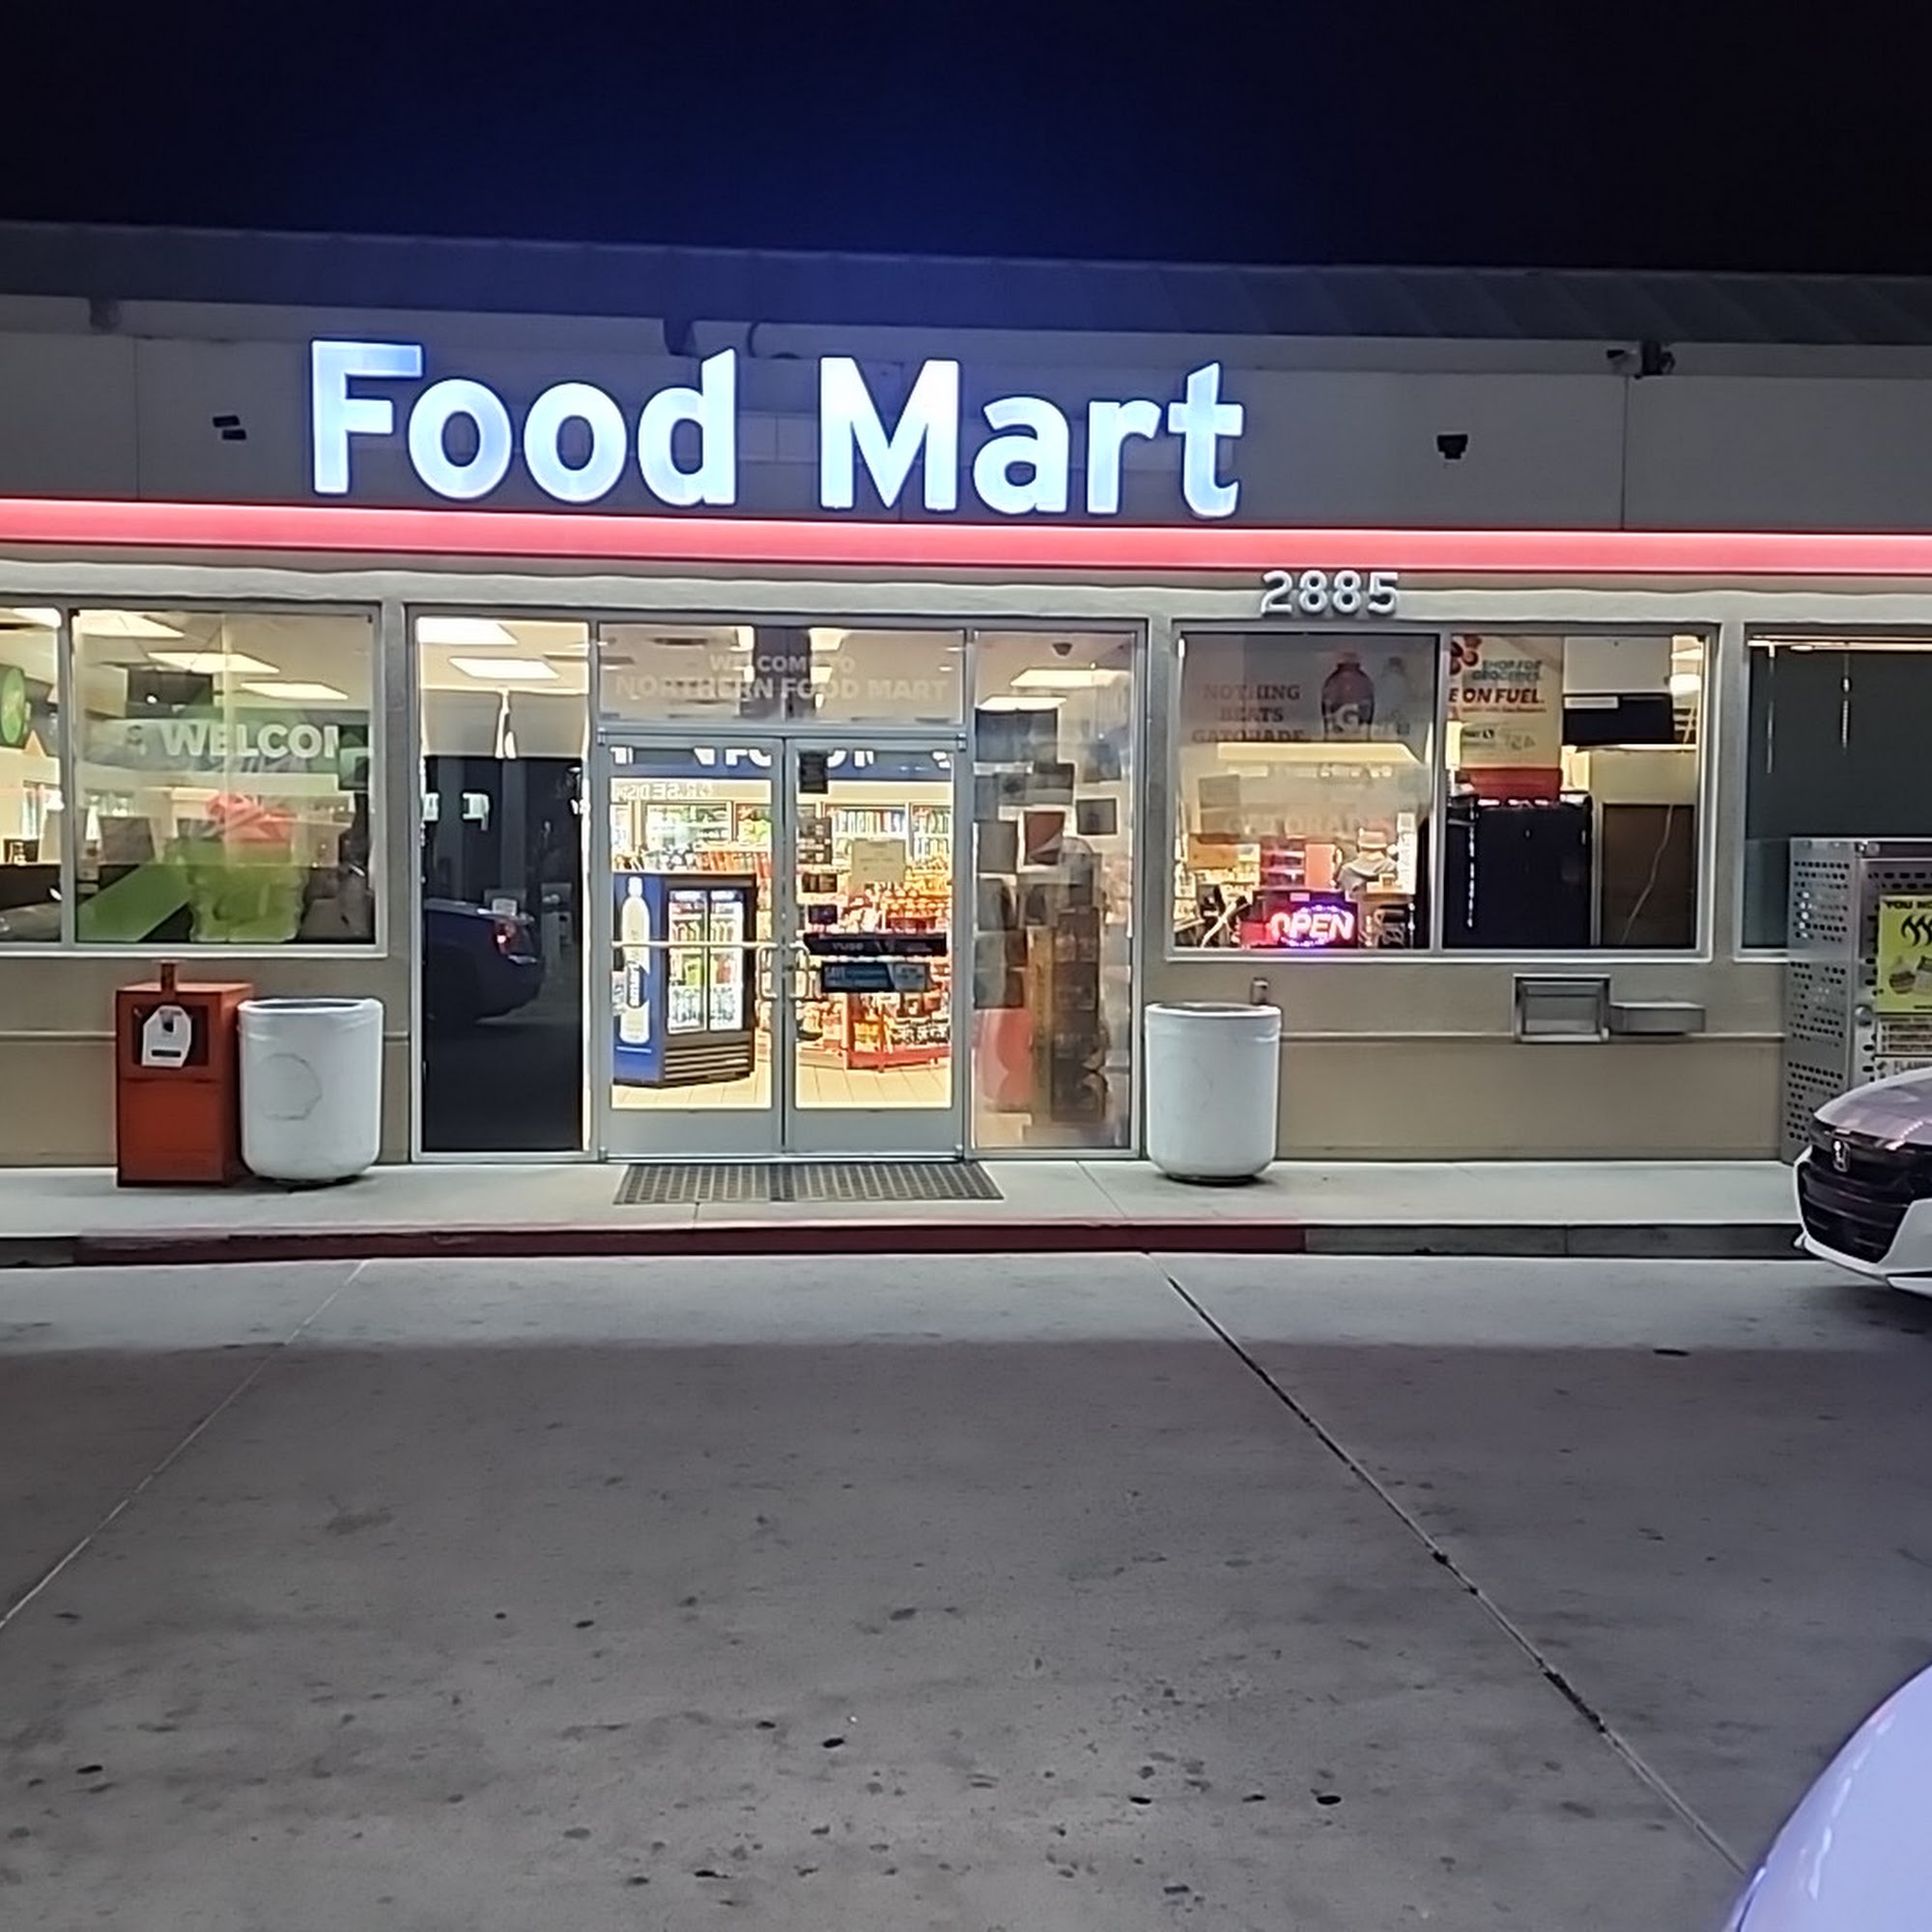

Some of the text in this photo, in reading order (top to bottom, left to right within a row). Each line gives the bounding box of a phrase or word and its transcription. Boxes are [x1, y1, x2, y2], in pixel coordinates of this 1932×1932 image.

[310, 340, 1245, 518] Food Mart
[1260, 570, 1399, 614] 2885
[710, 655, 819, 673] WECOM
[615, 677, 950, 701] NORTHERN FOOD MART
[1203, 684, 1300, 700] NOTHING
[1463, 688, 1492, 703] ON
[1219, 707, 1284, 723] BEATS
[1885, 900, 1913, 909] YOU
[1270, 912, 1354, 941] OPEN
